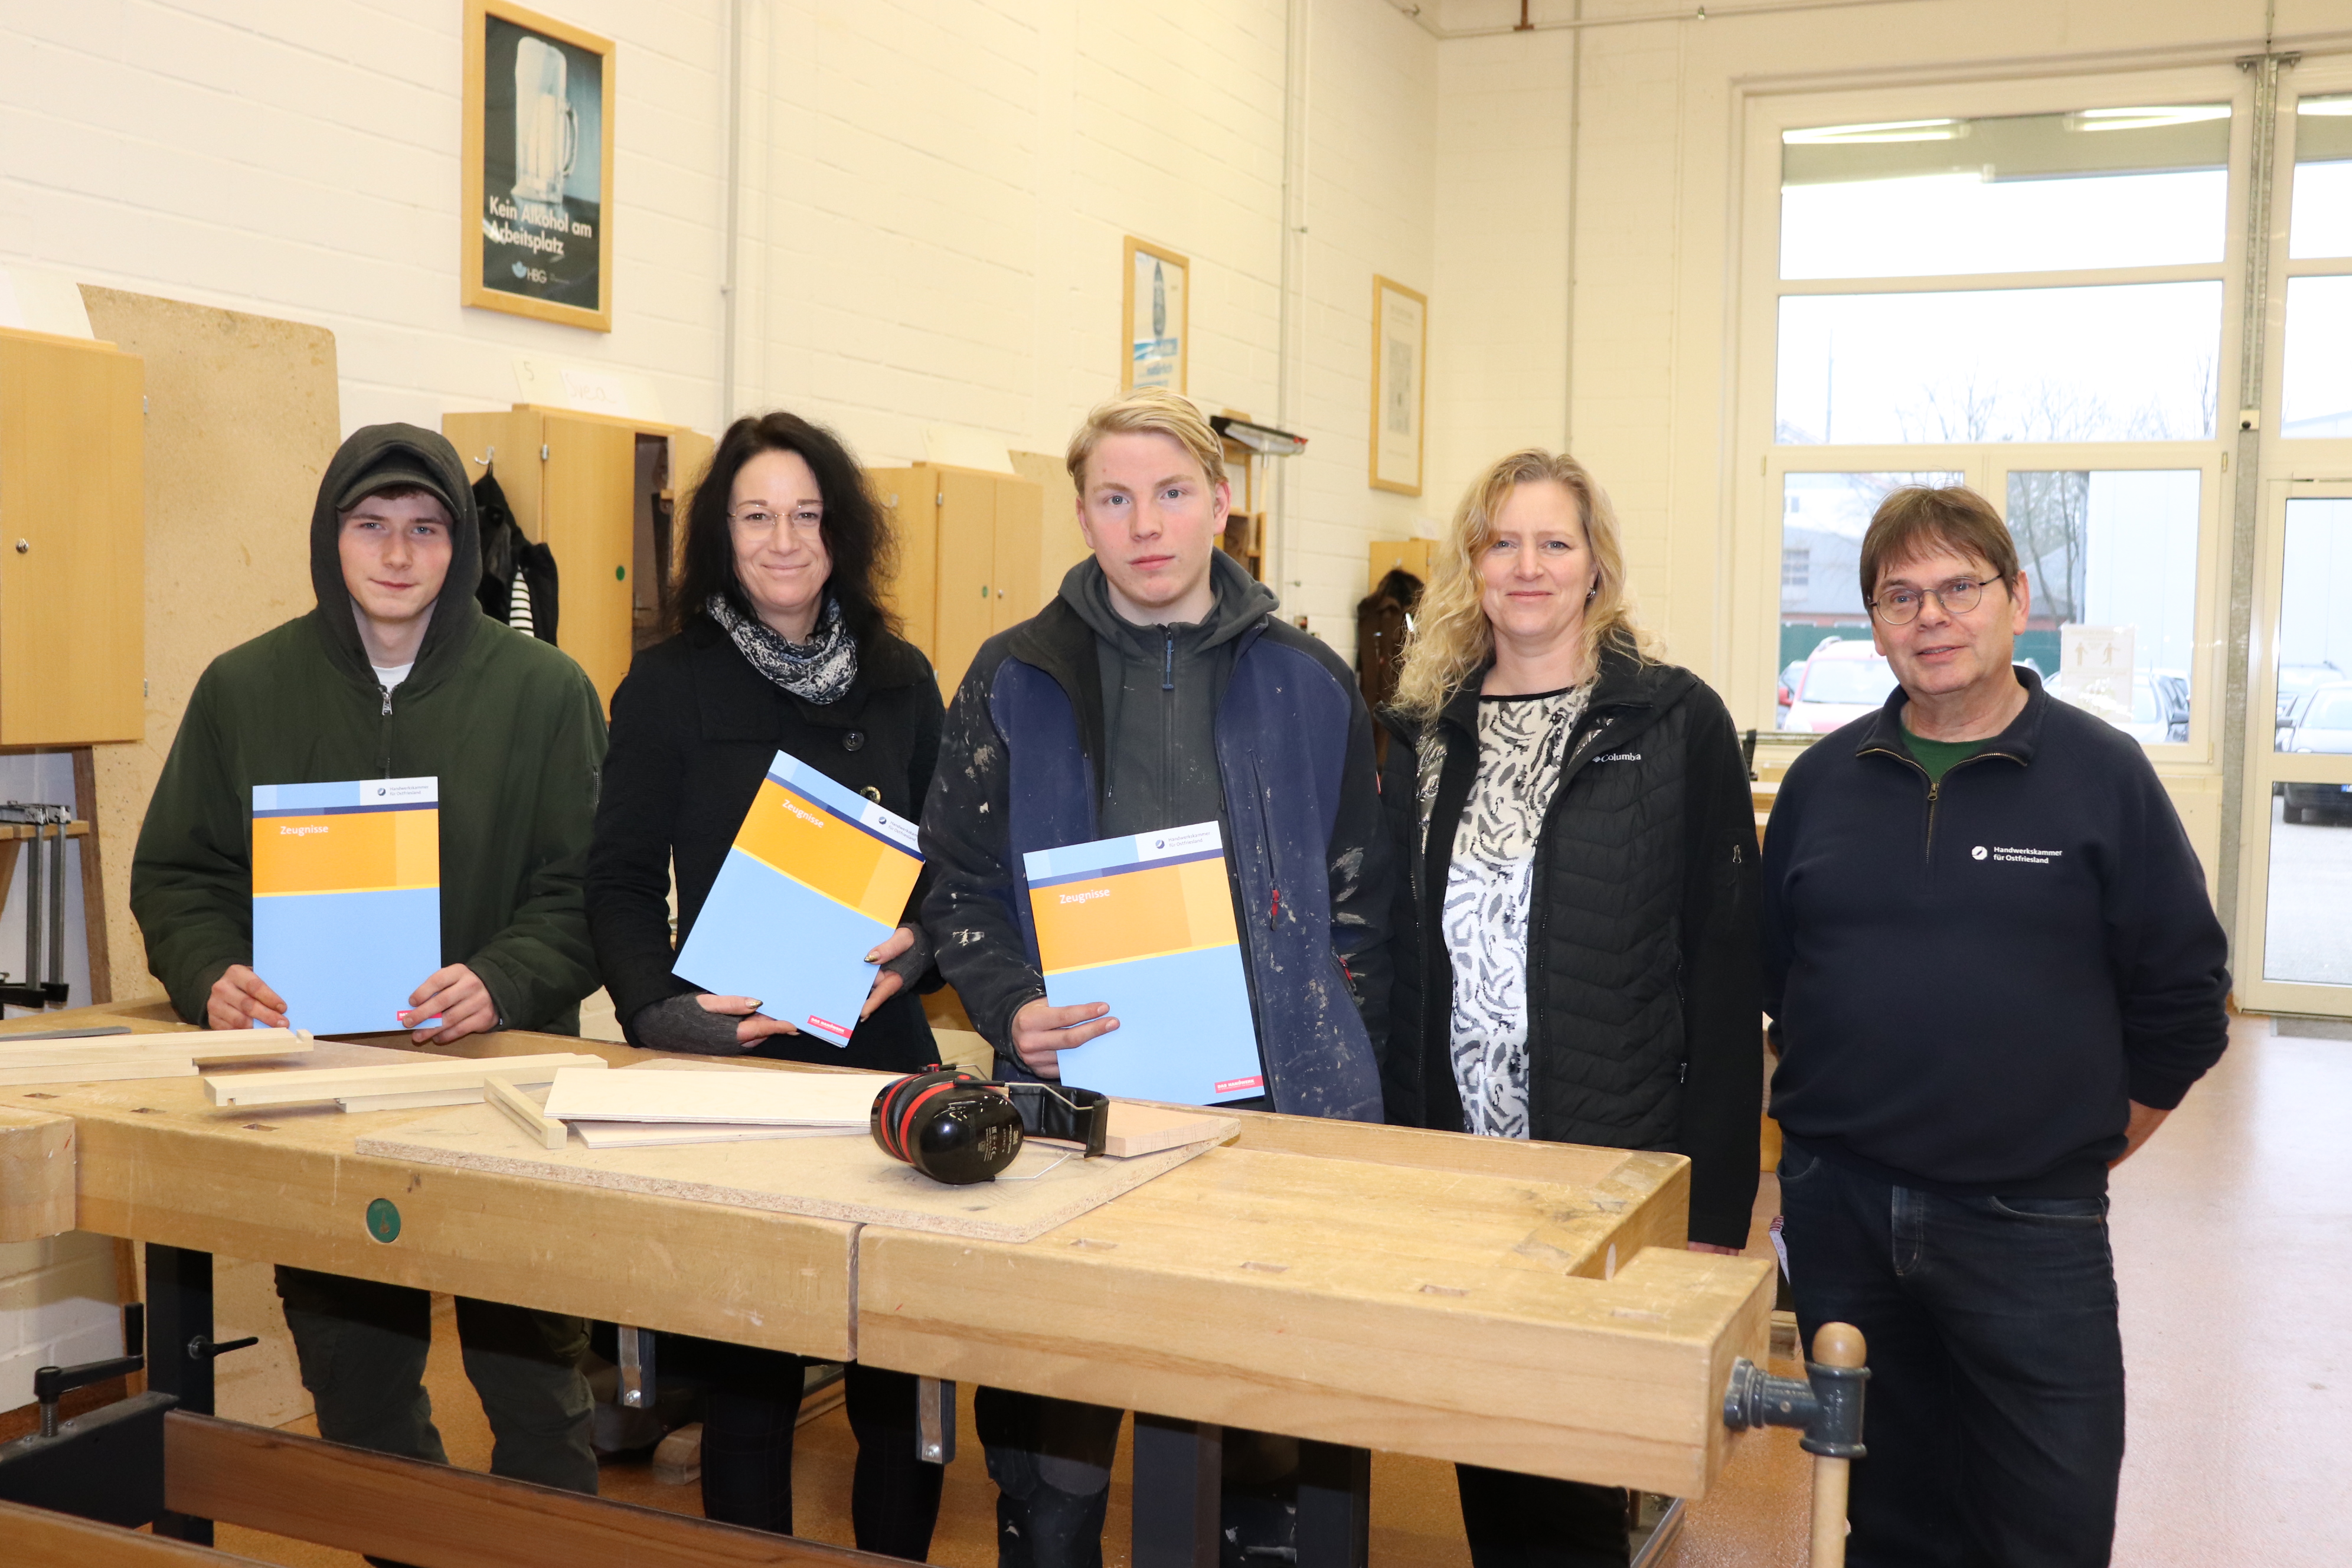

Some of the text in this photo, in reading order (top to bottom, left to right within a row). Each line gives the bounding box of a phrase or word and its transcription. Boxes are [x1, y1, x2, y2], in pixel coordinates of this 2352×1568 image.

[489, 195, 592, 239] Kein Alkohol am
[489, 220, 565, 255] Arbeitsplatz
[527, 267, 548, 285] HBG
[565, 373, 618, 404] Svea
[782, 799, 824, 828] Zeugnisse
[280, 825, 329, 837] Zeugnisse
[890, 821, 919, 838] Handwerkskam
[894, 828, 916, 842] Ostfriesland
[1168, 831, 1211, 842] Handwerkskammer
[1177, 838, 1203, 847] Ostfriesland
[1994, 846, 2063, 857] Handwerkskammer
[2005, 854, 2049, 864] Ostfriesland
[1059, 887, 1110, 904] Zeugnisse
[821, 1021, 845, 1033] HANDWERK
[1012, 1130, 1018, 1145] 3M
